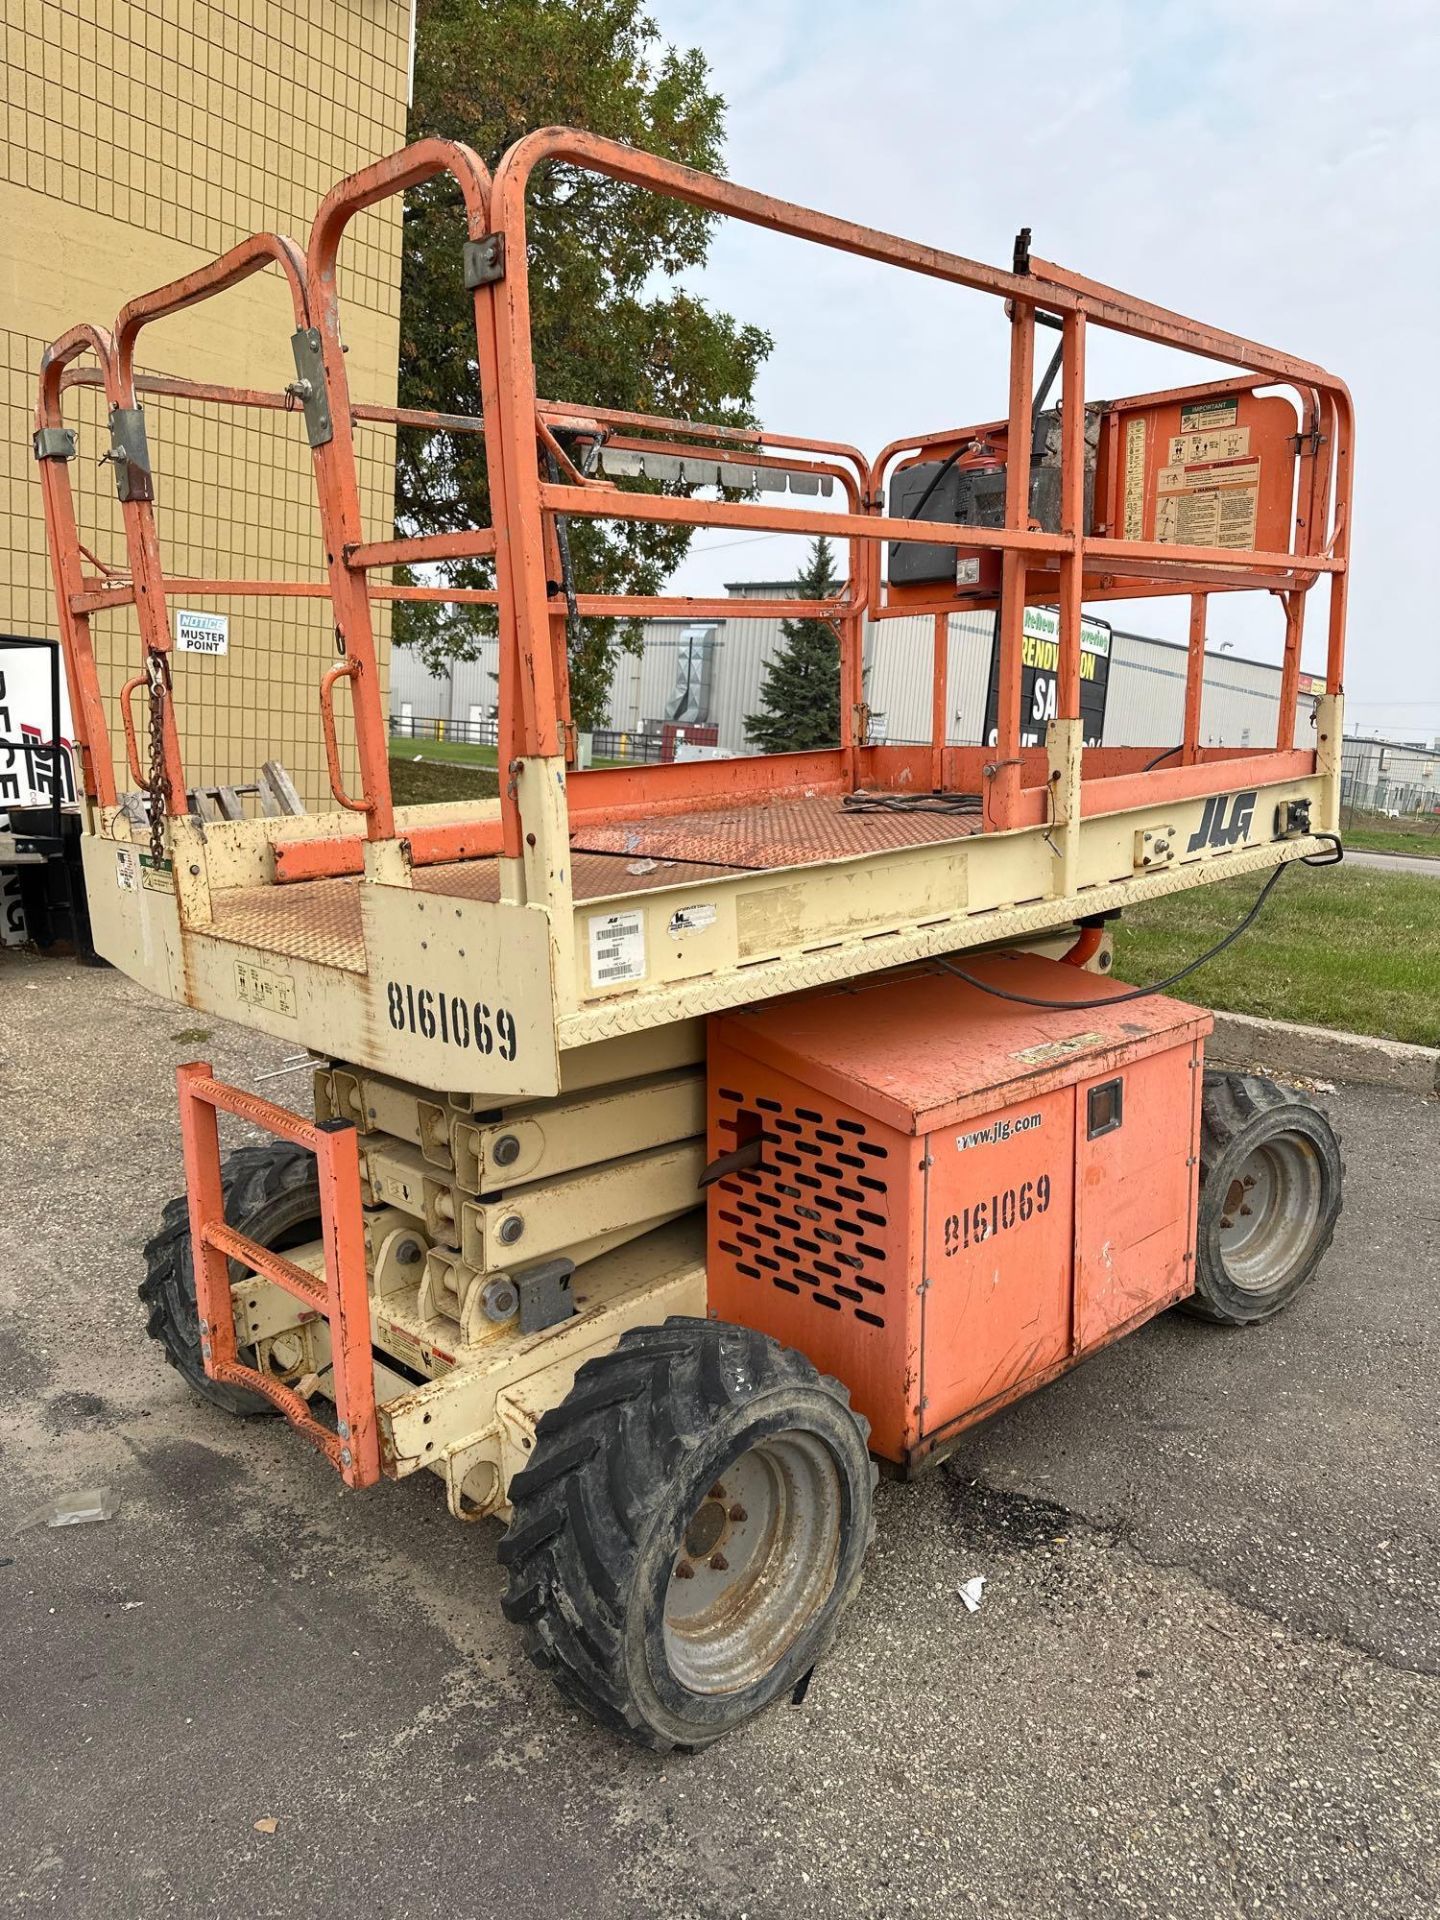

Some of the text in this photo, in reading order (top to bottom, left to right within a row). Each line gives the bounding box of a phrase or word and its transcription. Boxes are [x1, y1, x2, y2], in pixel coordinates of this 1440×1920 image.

[180, 613, 225, 630] NOTICE
[180, 629, 226, 643] MUSTER
[186, 640, 220, 653] POINT
[1186, 791, 1259, 854] JLG
[387, 981, 518, 1063] 8161069
[944, 1174, 1051, 1258] 8161069
